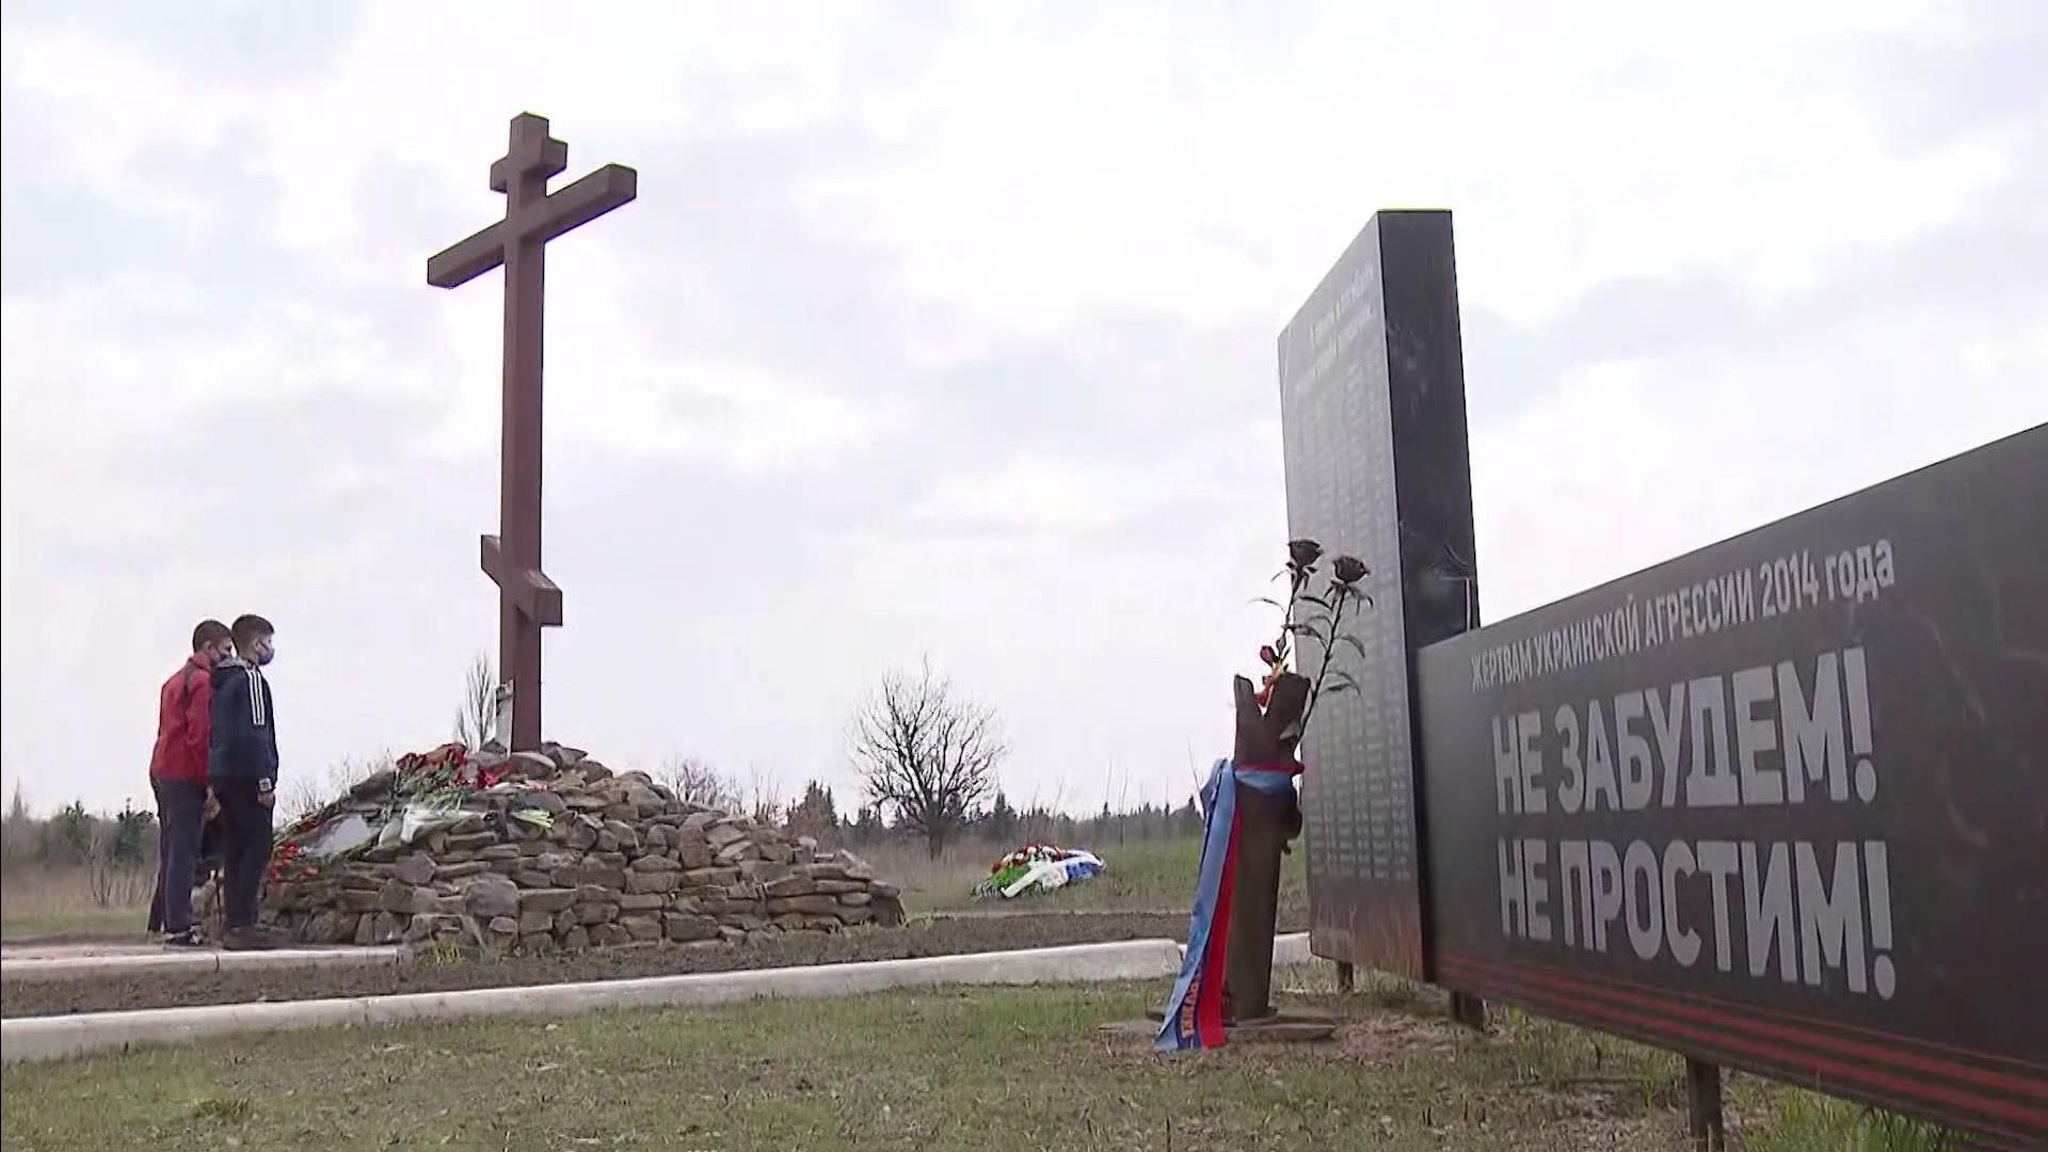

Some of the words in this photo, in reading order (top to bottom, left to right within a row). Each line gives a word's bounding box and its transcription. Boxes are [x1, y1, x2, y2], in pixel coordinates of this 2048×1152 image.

[1471, 637, 1533, 692] ЖЕРТВАМ
[1534, 593, 1640, 676] УКРАИНСКОЙ
[1645, 567, 1755, 648] АГРЕССИИ
[1759, 549, 1820, 618] 2014
[1825, 539, 1895, 603] года
[1492, 710, 1548, 815] НЕ
[1554, 645, 1878, 815] ЗАБУДЕМ!
[1498, 837, 1552, 942] НЕ
[1559, 838, 1896, 1001] ПРОСТИМ!
